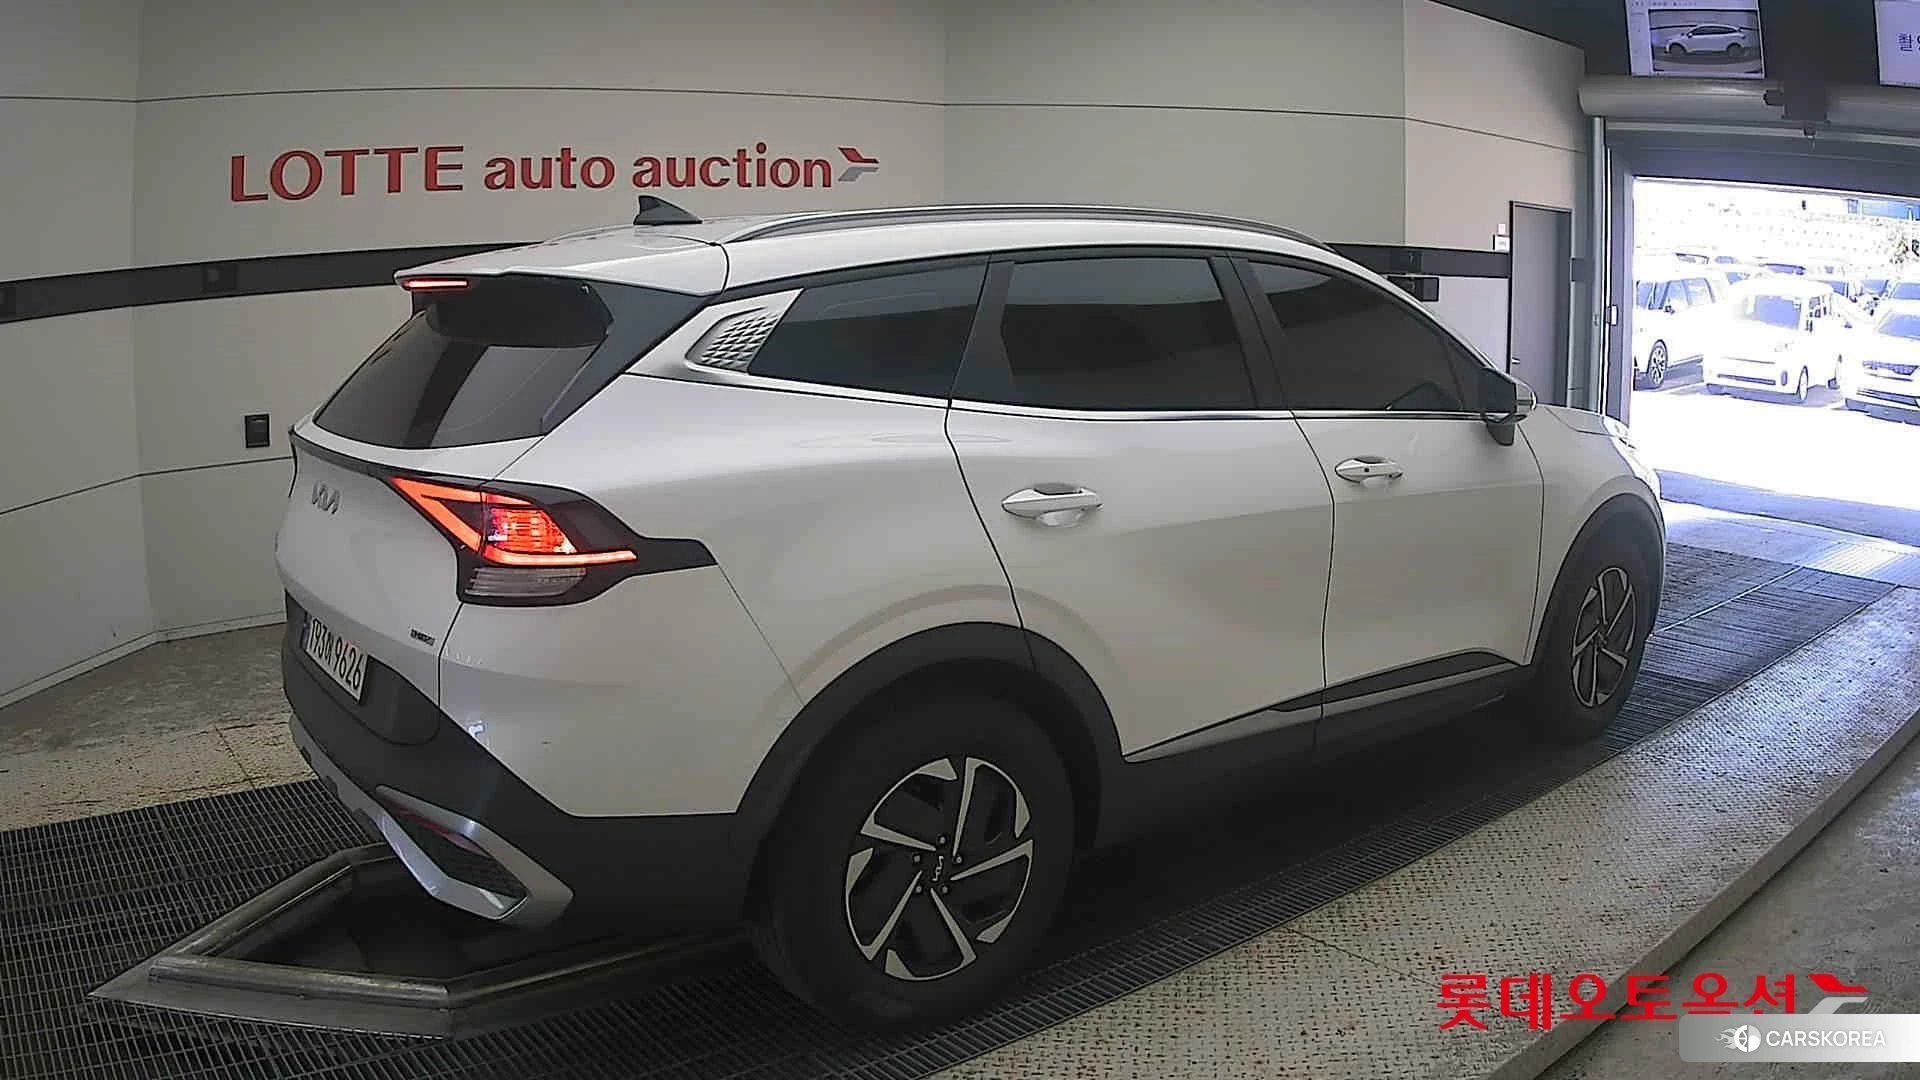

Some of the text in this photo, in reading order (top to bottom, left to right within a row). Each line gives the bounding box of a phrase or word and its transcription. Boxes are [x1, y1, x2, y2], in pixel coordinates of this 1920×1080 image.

[231, 143, 832, 201] LOTTE auto auction
[334, 636, 364, 690] 9626
